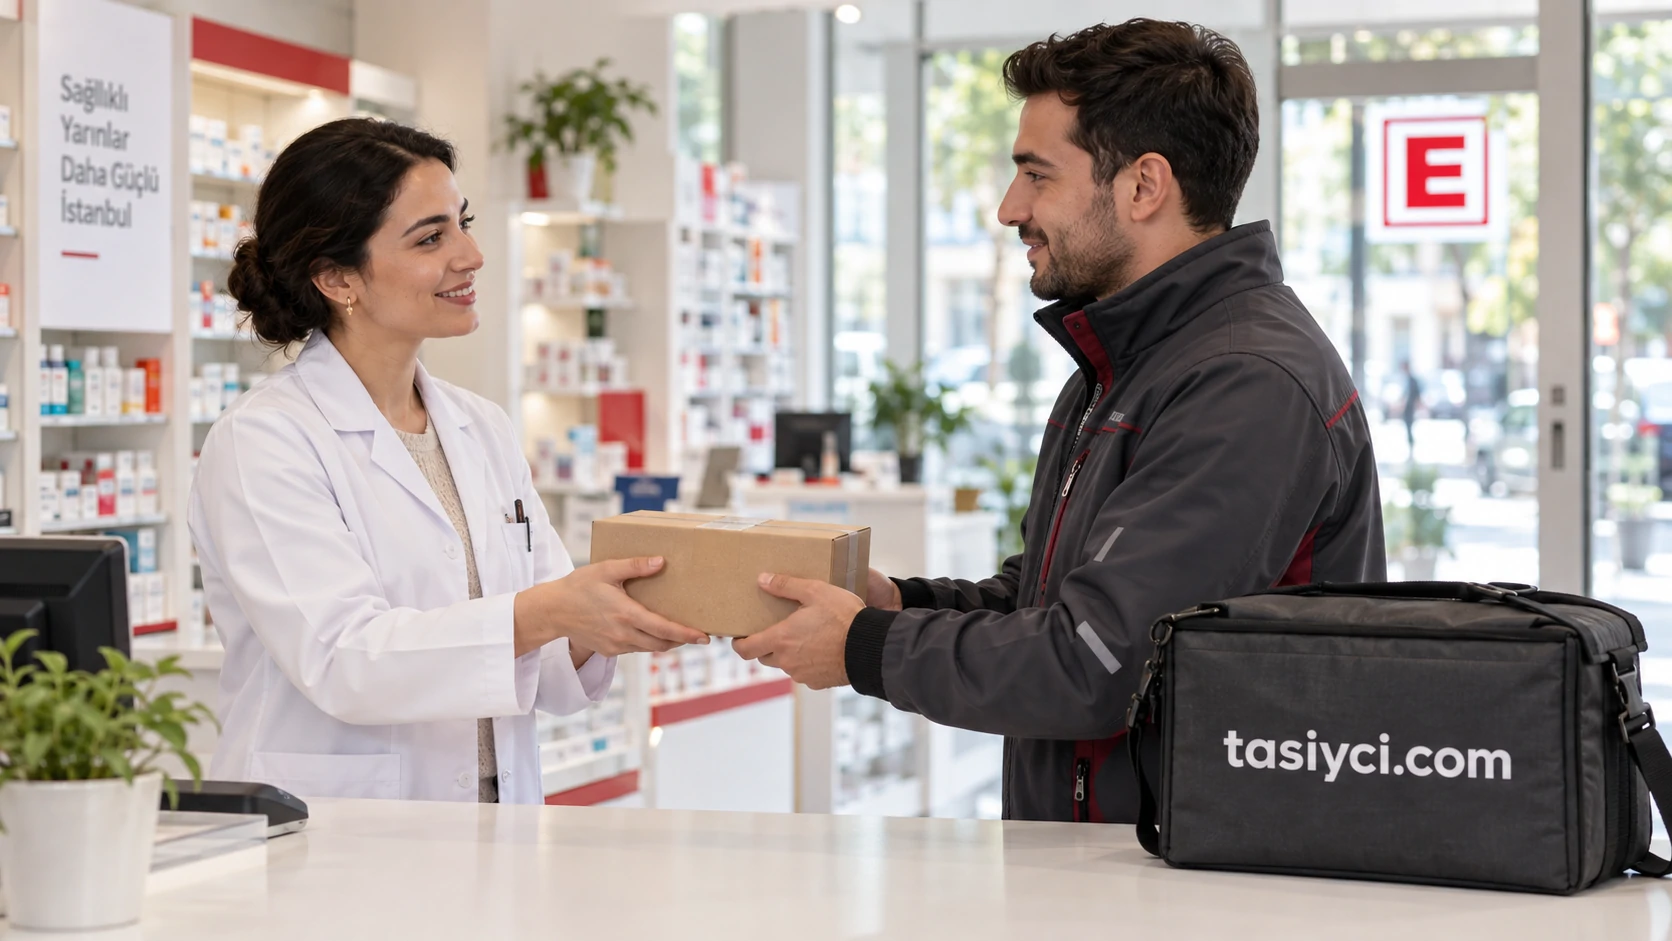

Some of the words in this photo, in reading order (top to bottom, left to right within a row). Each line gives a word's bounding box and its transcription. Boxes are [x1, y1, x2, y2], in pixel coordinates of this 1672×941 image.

[60, 114, 130, 151] Yarınlar
[61, 154, 107, 187] Daha
[110, 161, 159, 199] Güçlü
[1406, 136, 1465, 209] E
[61, 189, 132, 228] İstanbul
[1223, 729, 1512, 782] tasiyci.com
